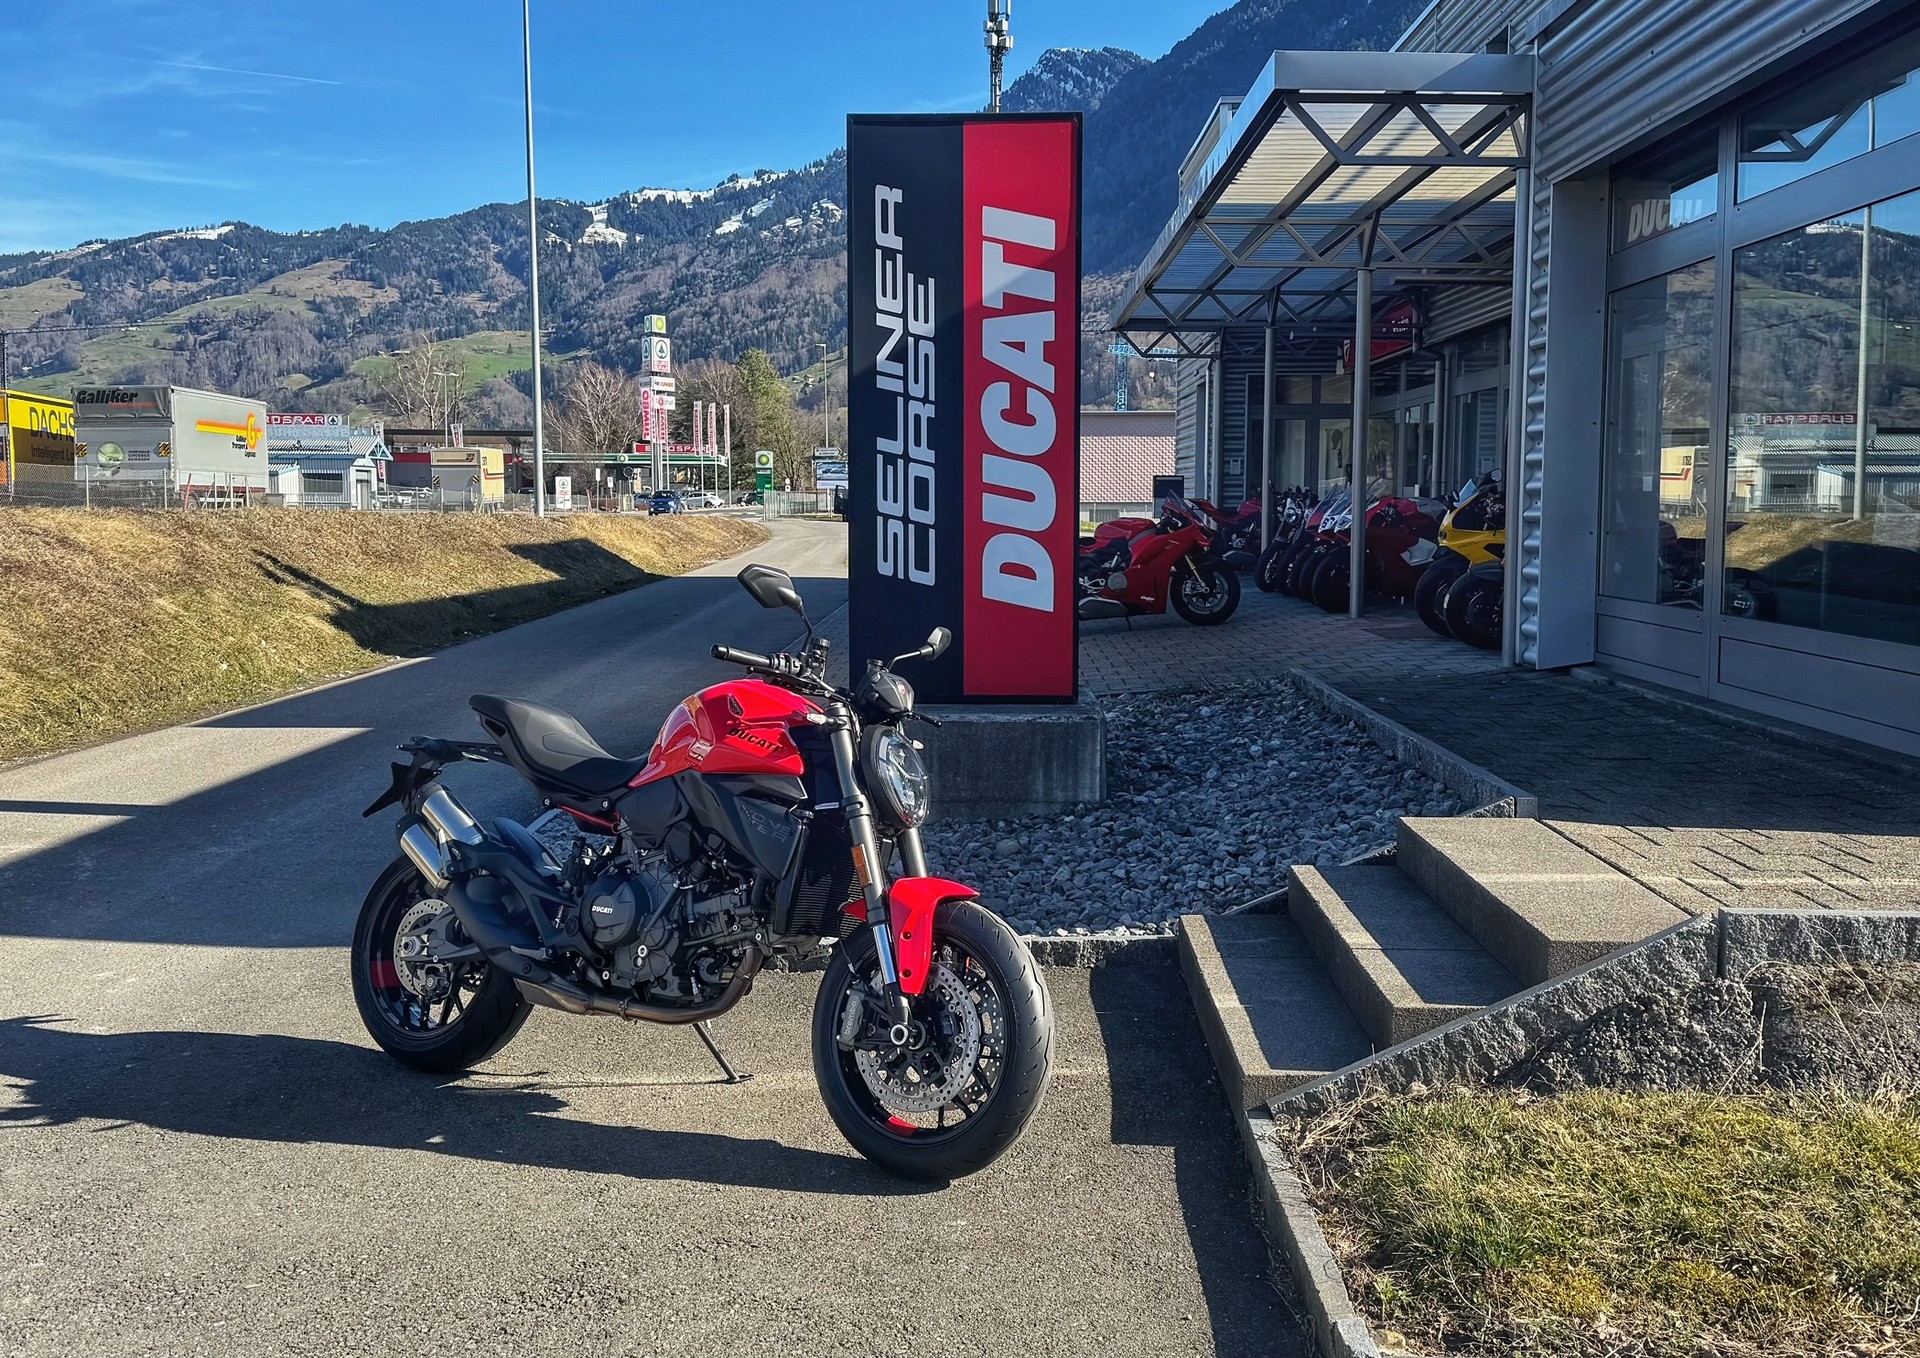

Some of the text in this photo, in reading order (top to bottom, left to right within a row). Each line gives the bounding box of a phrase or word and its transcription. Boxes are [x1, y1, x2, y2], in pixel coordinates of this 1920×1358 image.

[76, 387, 138, 404] Galliker
[875, 184, 904, 580] SELINER
[980, 205, 1057, 612] DUCATI
[907, 272, 936, 586] CORSE
[31, 444, 65, 461] Intelligent
[727, 727, 782, 753] DUCATI
[592, 905, 613, 914] DUCATI
[844, 1001, 857, 1035] brembo
